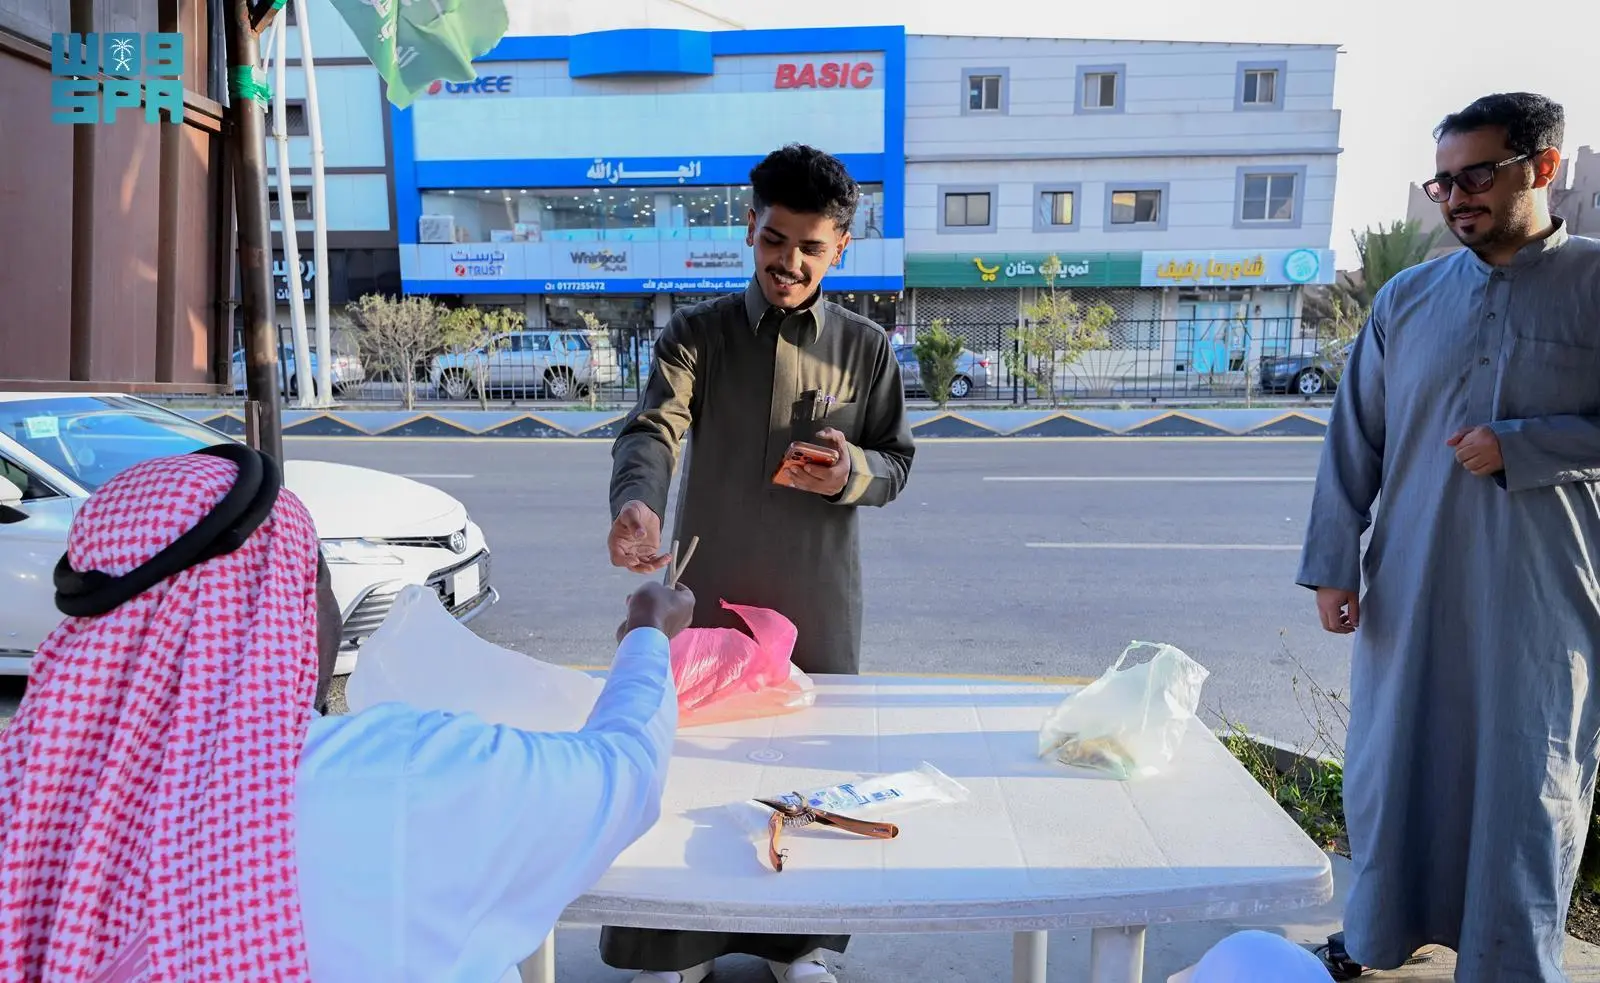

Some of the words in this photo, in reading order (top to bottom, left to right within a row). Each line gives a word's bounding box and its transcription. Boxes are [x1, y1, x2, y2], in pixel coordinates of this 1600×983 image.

[775, 62, 874, 89] BASIC
[467, 265, 503, 275] TRUST
[1005, 260, 1035, 277] حنان
[1207, 255, 1264, 280] شاورما
[724, 279, 749, 289] ؤسسة
